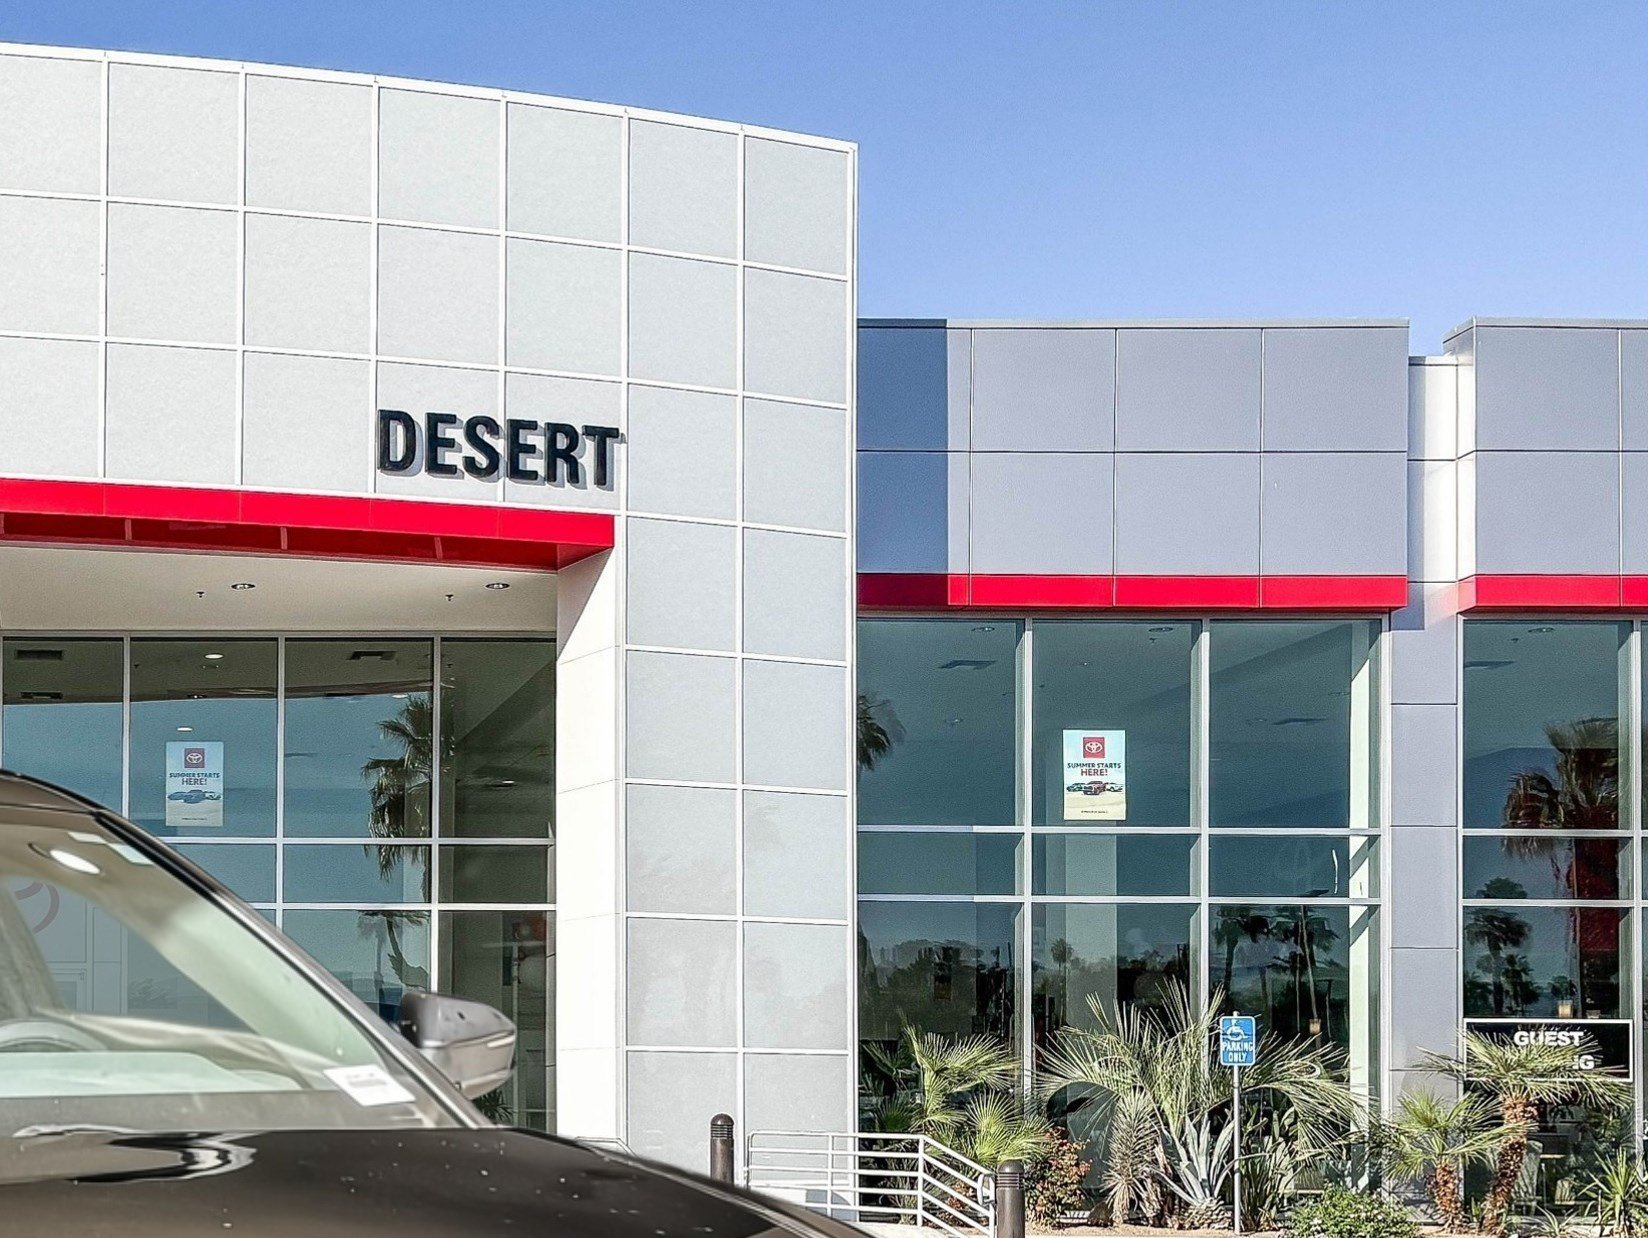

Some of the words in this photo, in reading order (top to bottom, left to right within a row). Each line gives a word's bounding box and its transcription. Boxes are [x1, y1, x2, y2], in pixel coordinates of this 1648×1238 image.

[377, 409, 619, 486] DESERT
[1514, 1031, 1584, 1047] GUEST
[1222, 1042, 1254, 1051] PARKING
[1228, 1052, 1248, 1062] ONLY
